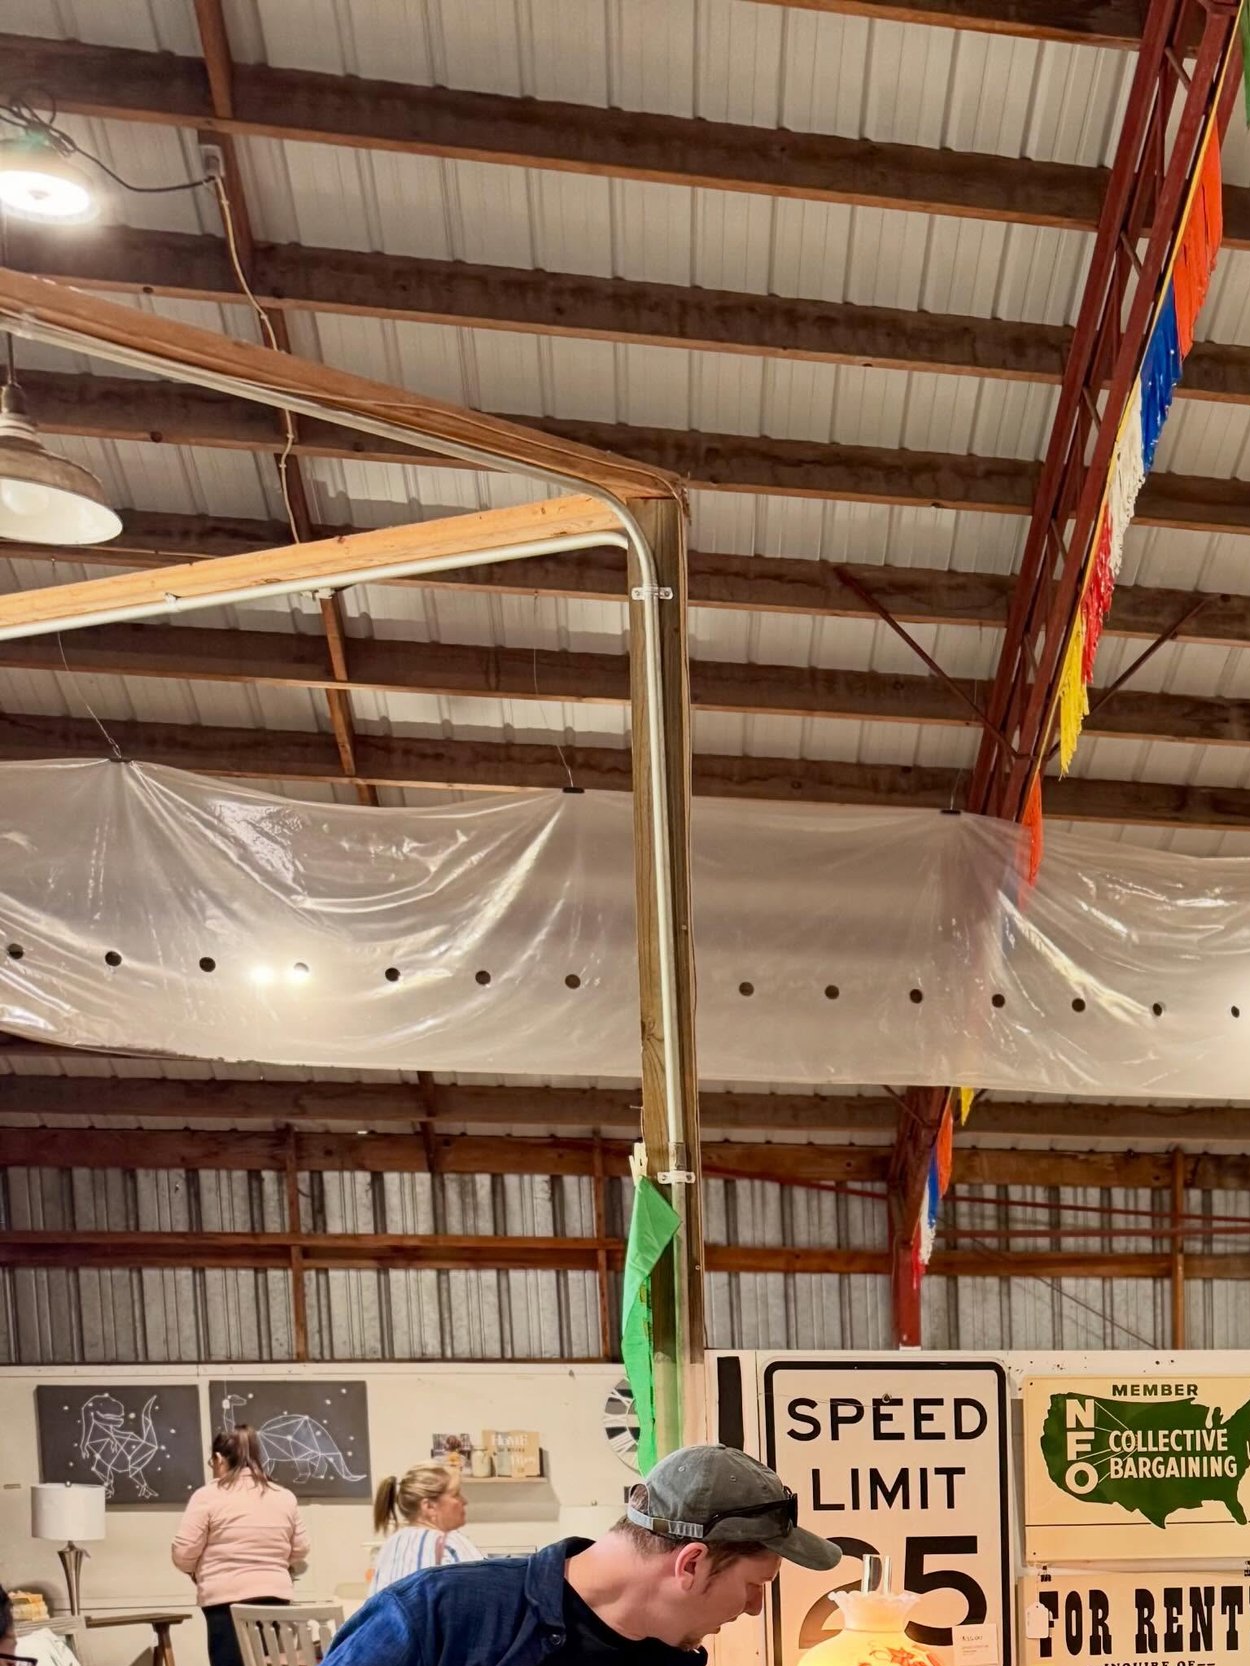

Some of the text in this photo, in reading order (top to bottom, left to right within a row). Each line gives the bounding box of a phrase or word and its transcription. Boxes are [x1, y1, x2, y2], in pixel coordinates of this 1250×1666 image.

[1112, 1384, 1199, 1397] MEMBER
[787, 1398, 988, 1441] SPEED
[1108, 1429, 1228, 1452] COLLECTIVE
[1110, 1455, 1238, 1479] BARGAINING
[812, 1467, 966, 1511] LIMIT
[1039, 1589, 1112, 1658] FOR
